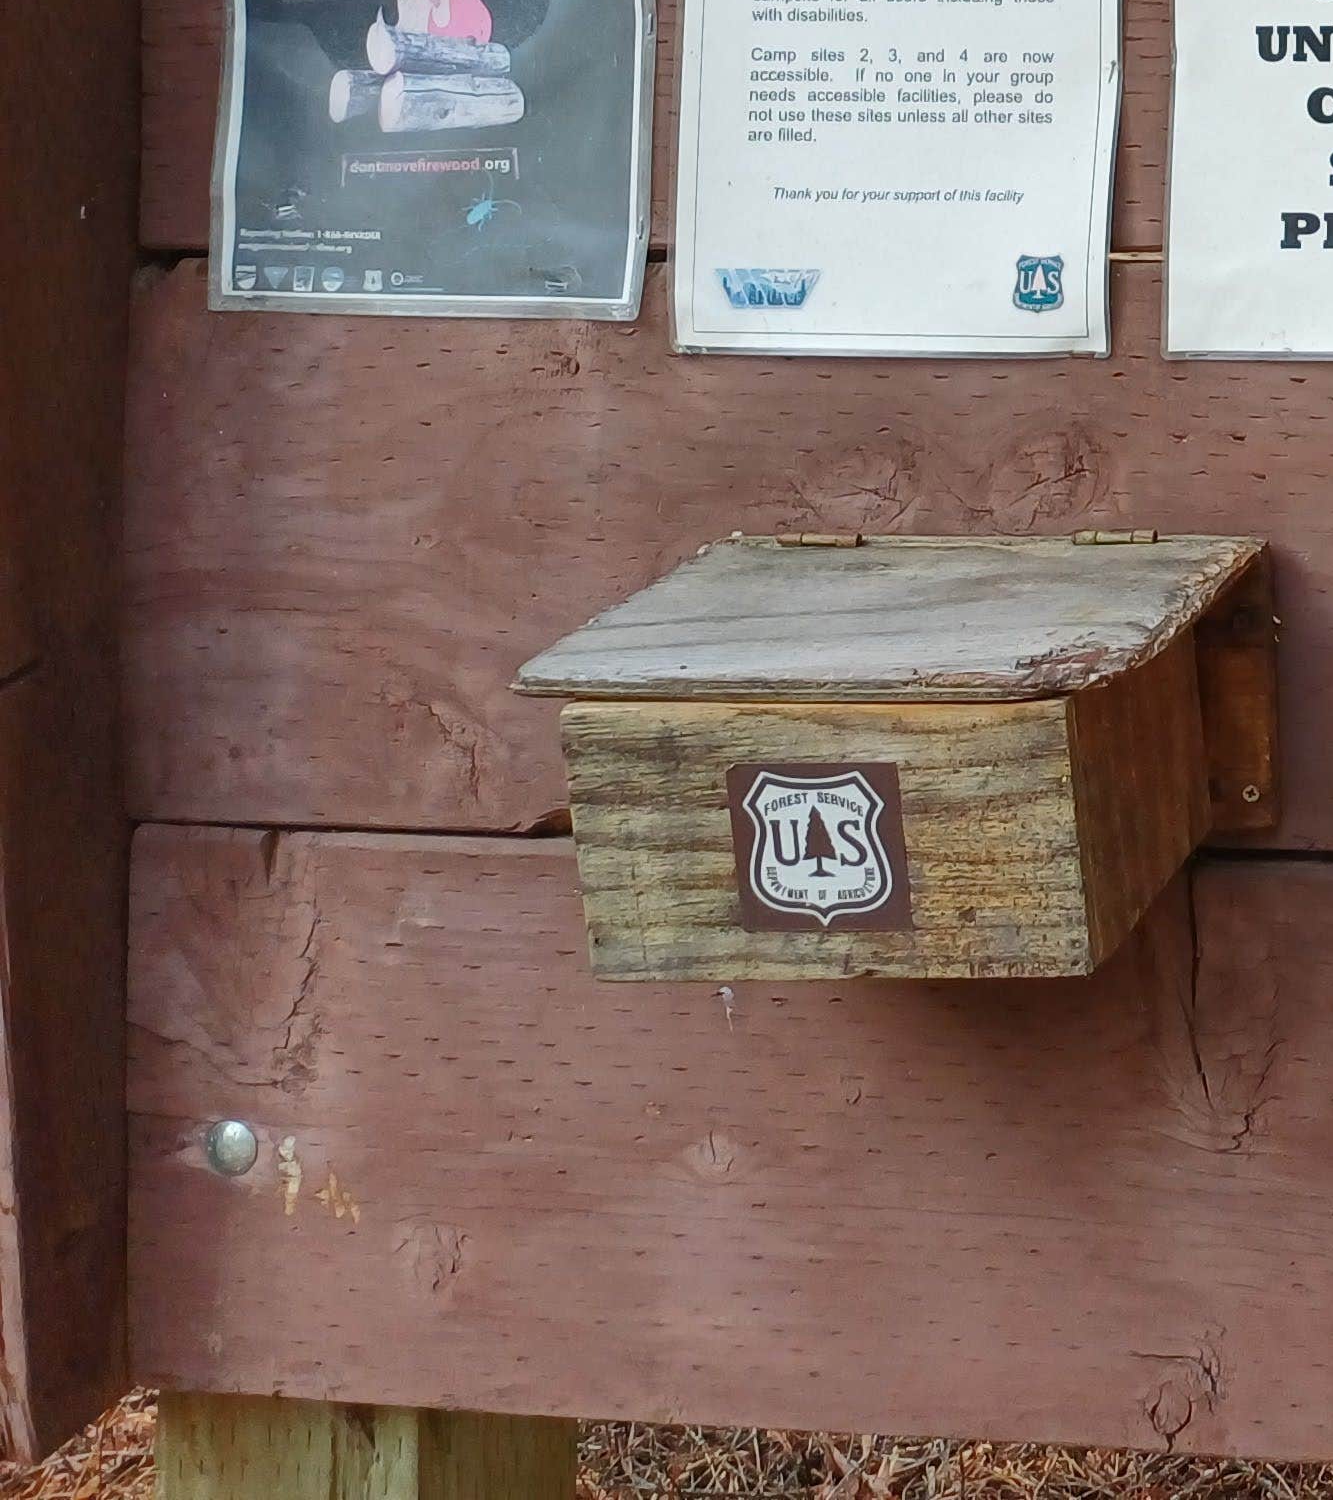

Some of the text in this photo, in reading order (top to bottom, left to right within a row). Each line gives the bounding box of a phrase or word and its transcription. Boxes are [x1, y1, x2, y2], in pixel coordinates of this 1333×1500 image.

[350, 157, 512, 175] dontmovefirewood.org
[763, 792, 865, 816] FOREST SERVICE
